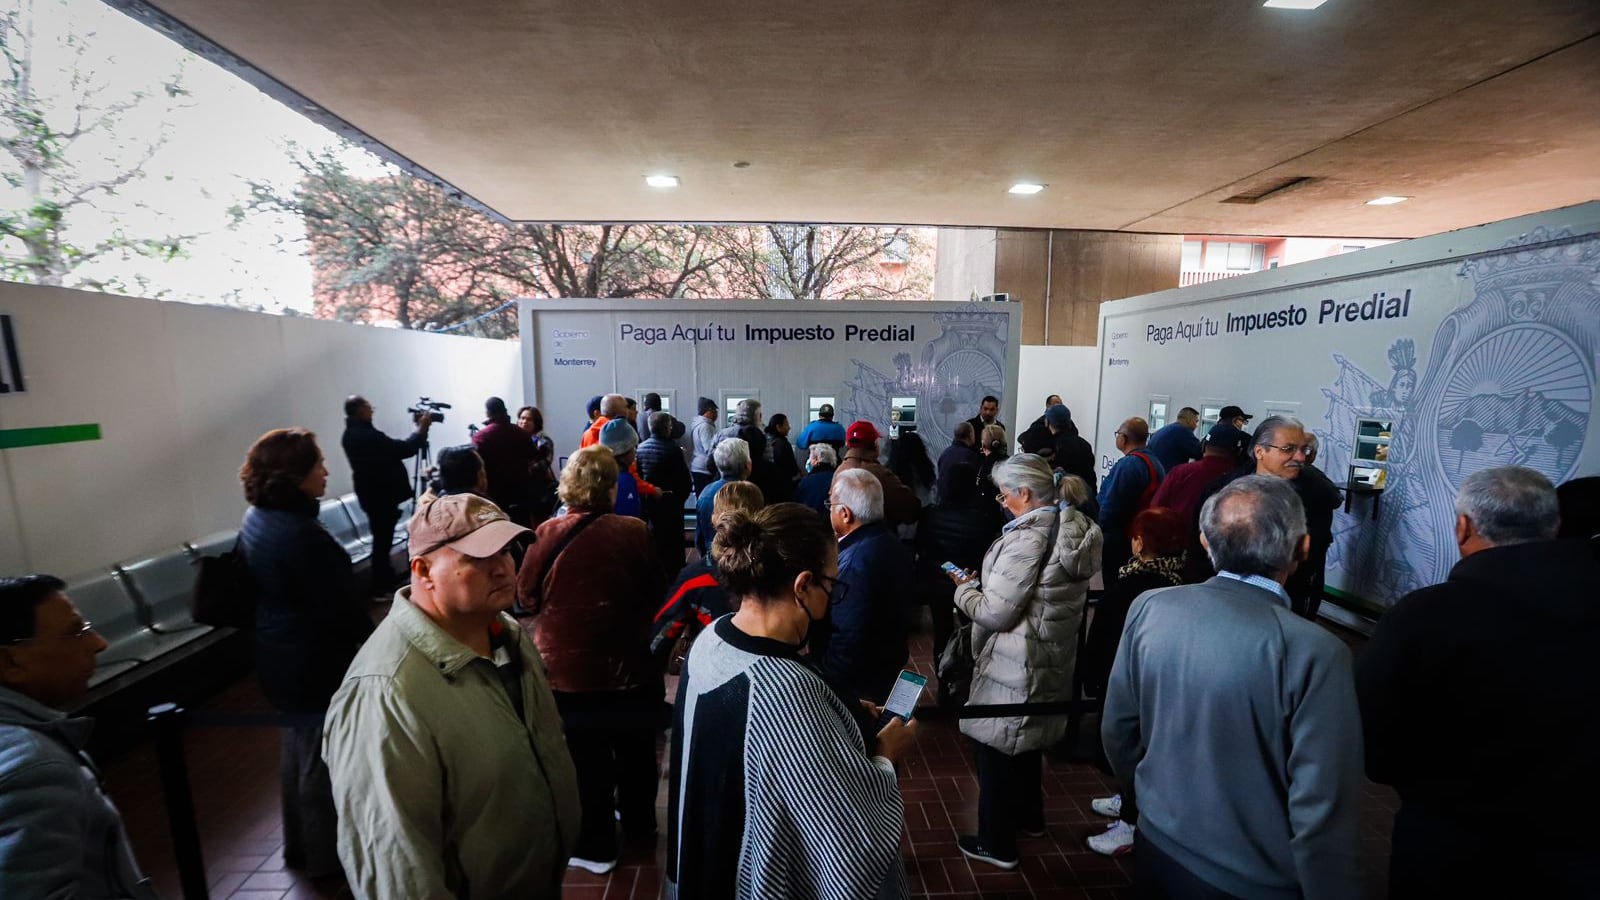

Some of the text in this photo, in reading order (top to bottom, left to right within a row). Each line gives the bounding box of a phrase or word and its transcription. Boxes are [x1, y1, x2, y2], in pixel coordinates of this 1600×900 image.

[1146, 289, 1411, 345] Paga Aquí tu Impuesto Predial
[620, 322, 915, 345] Paga Aquí tu Impuesto Predial
[554, 358, 597, 367] Monterrey
